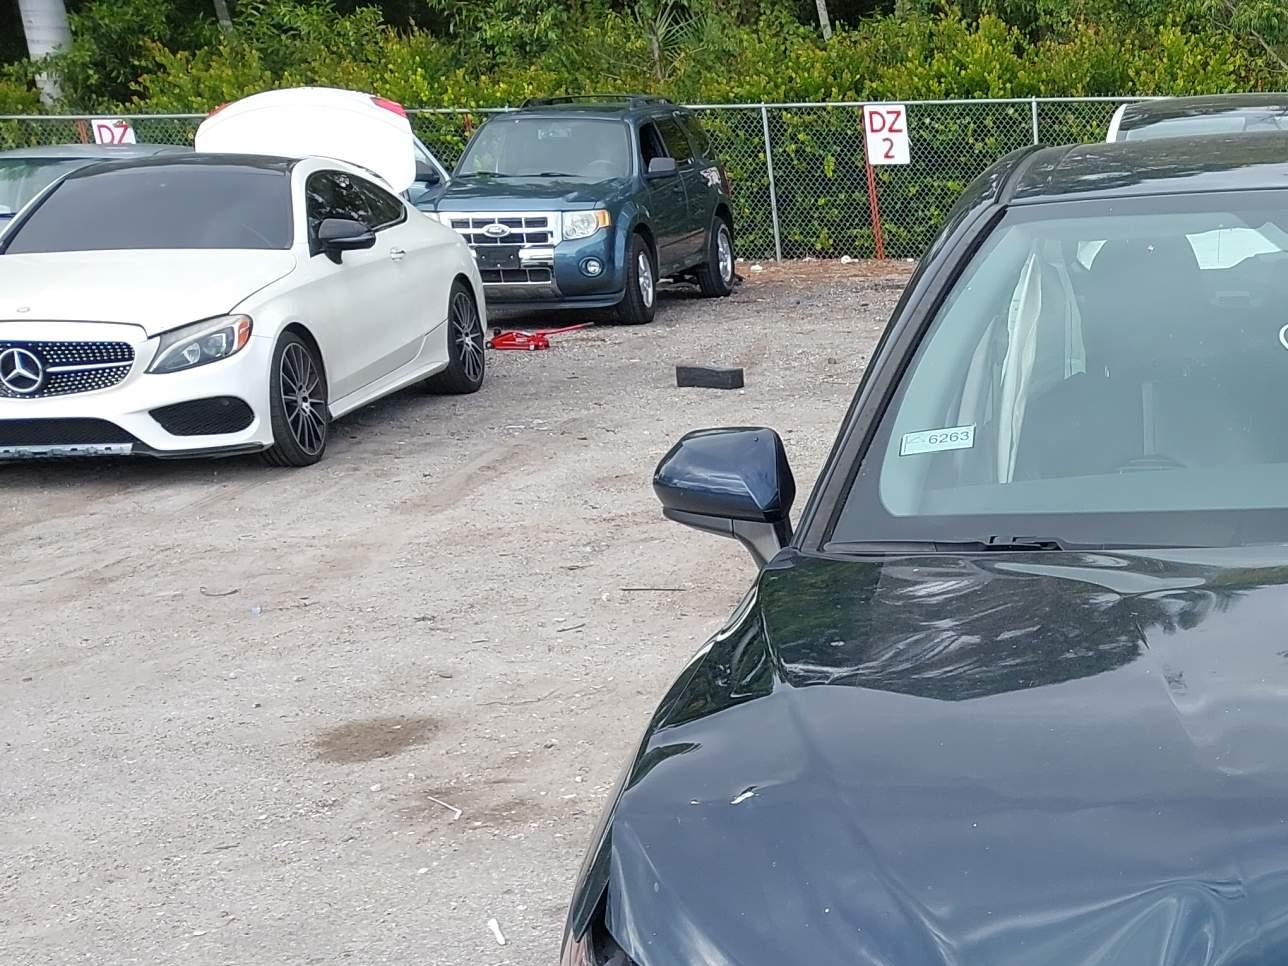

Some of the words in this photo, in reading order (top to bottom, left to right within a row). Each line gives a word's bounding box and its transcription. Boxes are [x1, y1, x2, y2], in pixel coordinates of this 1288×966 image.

[869, 111, 903, 133] DZ
[97, 124, 130, 144] DZ
[882, 137, 895, 159] 2
[928, 431, 970, 445] 6263
